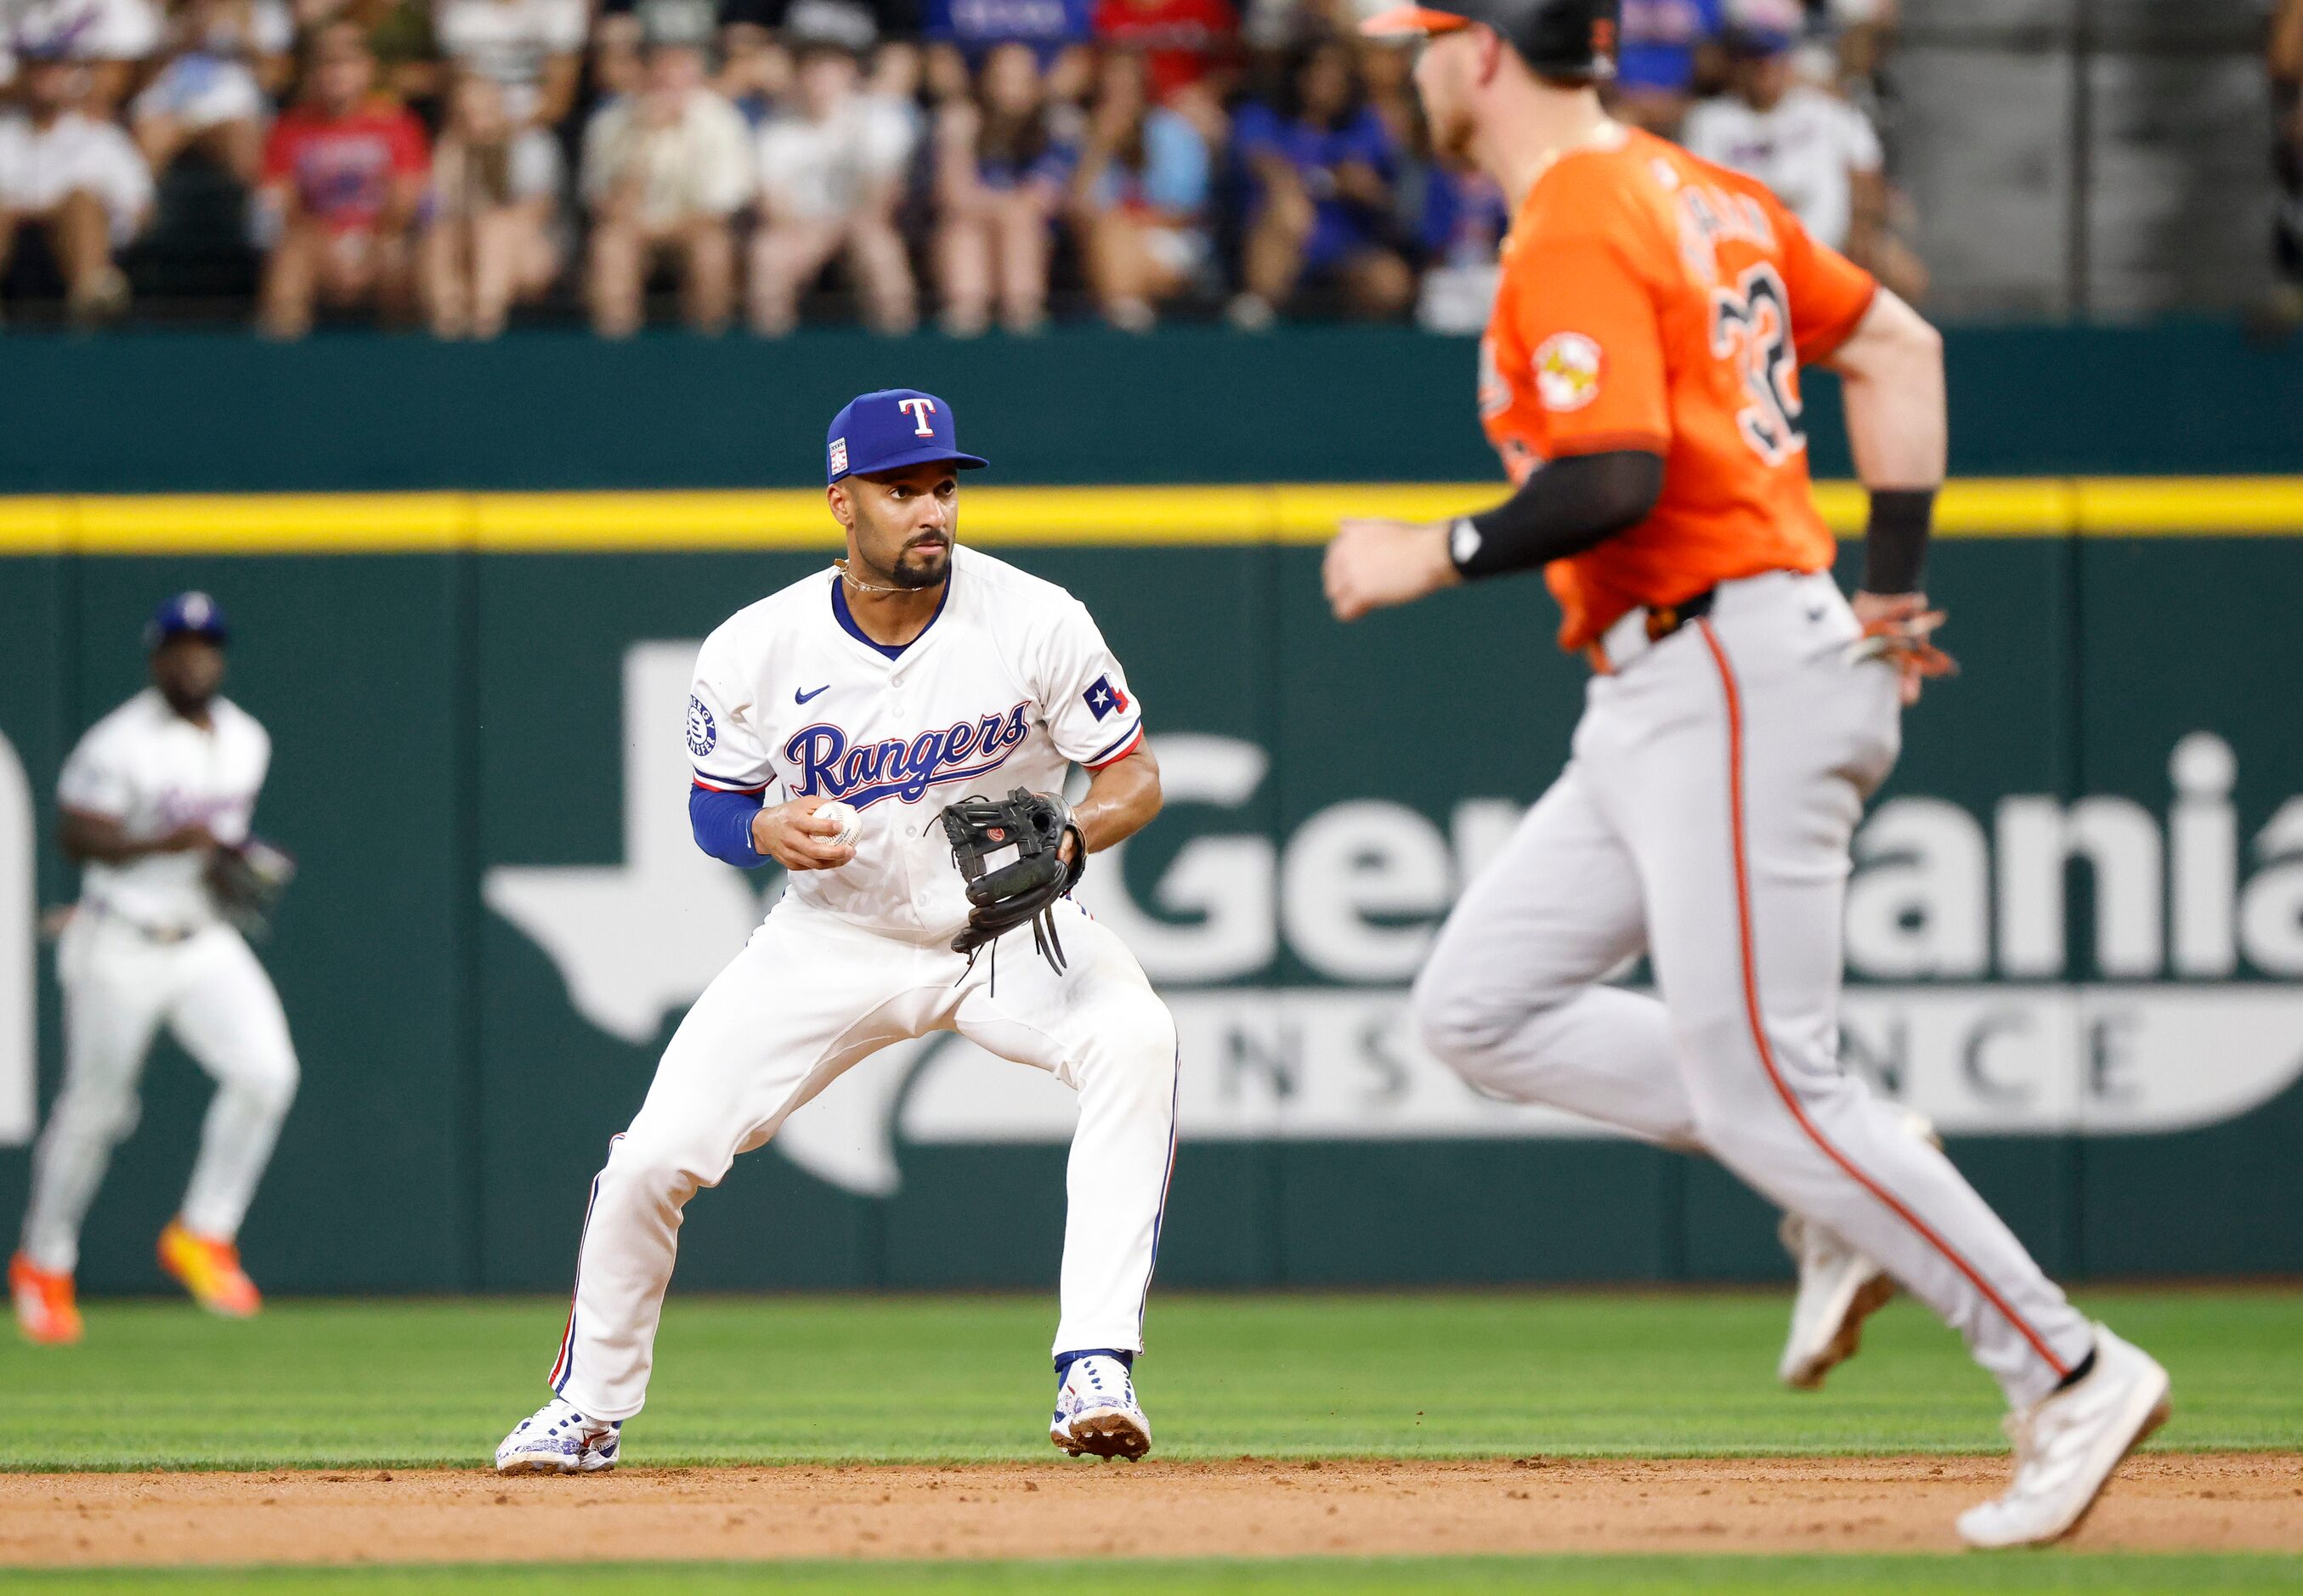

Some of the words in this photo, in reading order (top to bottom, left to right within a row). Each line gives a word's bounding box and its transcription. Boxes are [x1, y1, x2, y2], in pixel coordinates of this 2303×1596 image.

[1708, 261, 1808, 467] 32
[897, 398, 936, 438] T
[689, 694, 716, 728] ERGY
[784, 701, 1032, 813] Rangers
[1062, 730, 2303, 984] Geani
[1219, 1015, 2147, 1105] NSNCE
